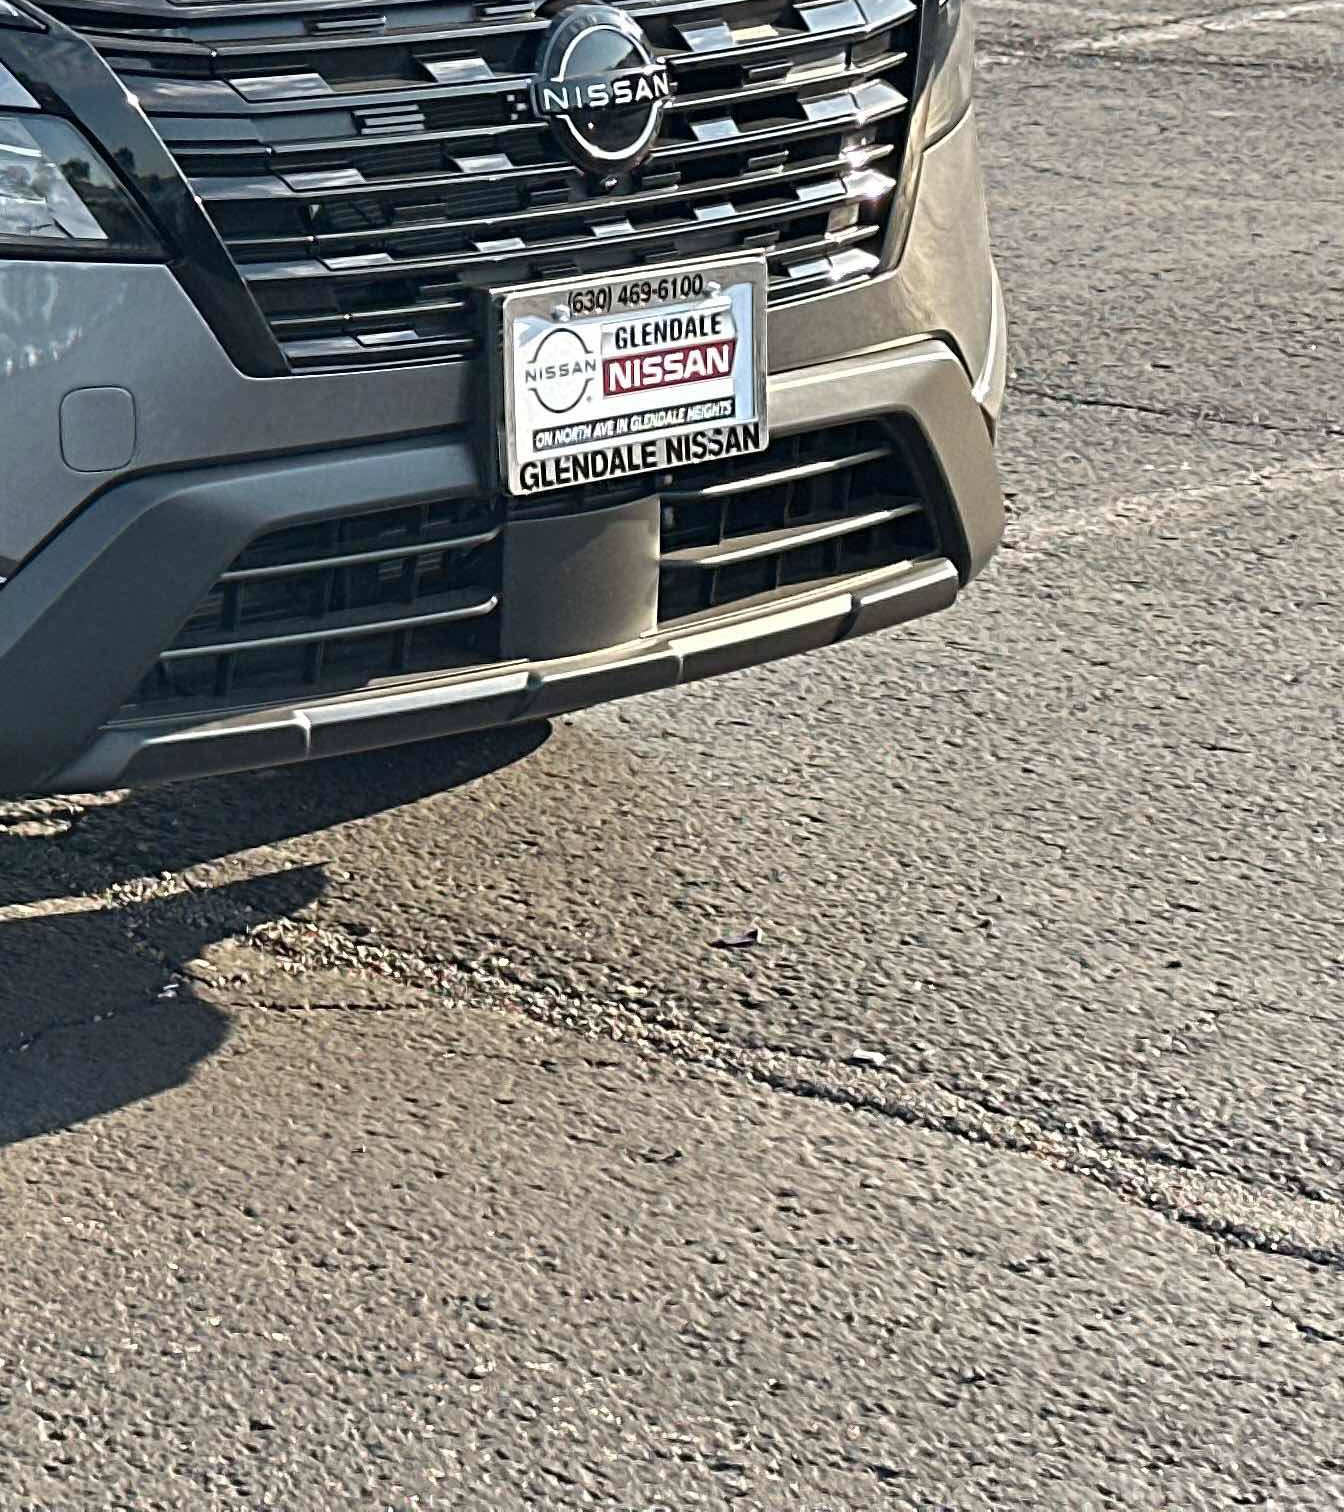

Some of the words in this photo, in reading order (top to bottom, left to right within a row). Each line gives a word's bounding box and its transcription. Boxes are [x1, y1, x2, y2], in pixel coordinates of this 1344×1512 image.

[543, 72, 670, 110] NISSAN
[567, 285, 612, 313] (630)
[617, 273, 704, 306] 469-6100
[615, 311, 722, 350] GLENDALE
[525, 359, 597, 384] NISSAN
[608, 343, 730, 392] NISSAN
[535, 430, 553, 447] ON
[554, 424, 592, 445] NORTH
[593, 420, 614, 440] AVE
[616, 417, 628, 433] IN
[630, 407, 686, 432] GLENDALE
[687, 399, 733, 422] HEIGHTS
[520, 441, 657, 490] GLENDALE
[665, 423, 760, 465] NISSAN
